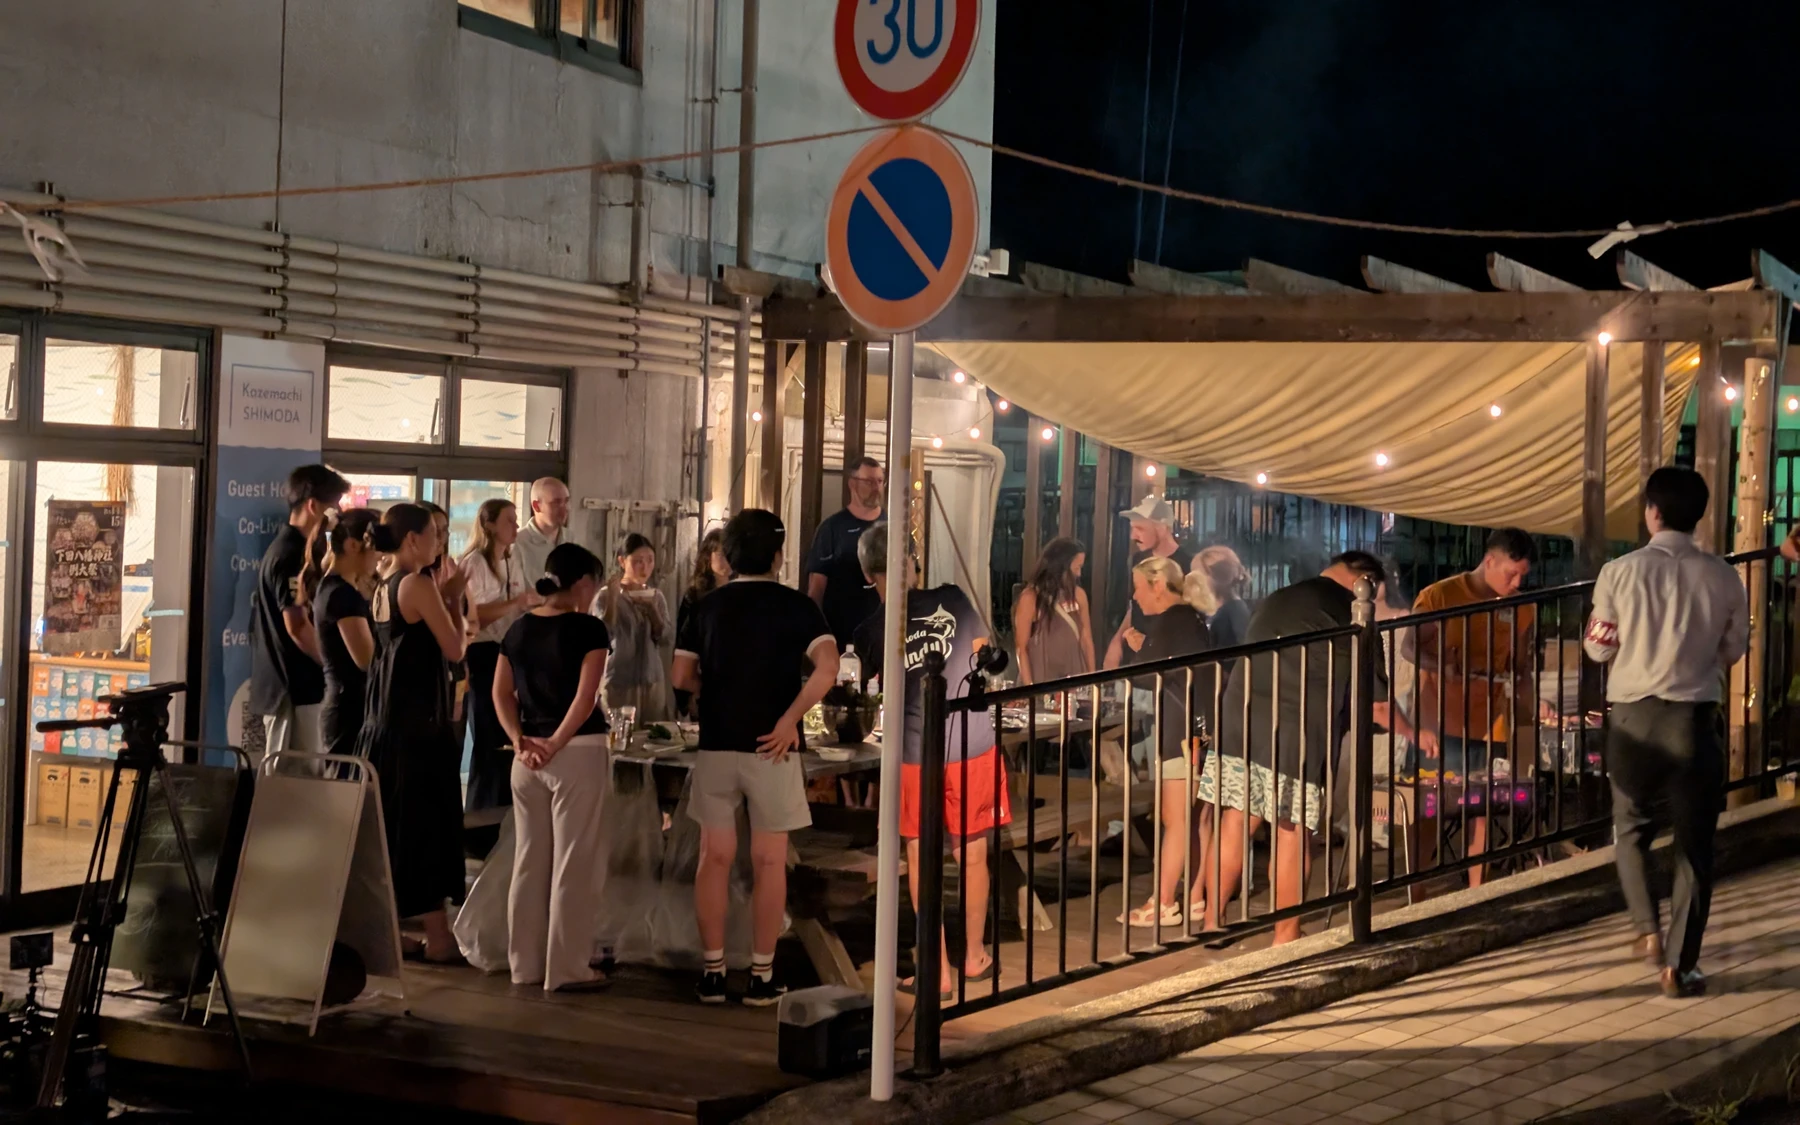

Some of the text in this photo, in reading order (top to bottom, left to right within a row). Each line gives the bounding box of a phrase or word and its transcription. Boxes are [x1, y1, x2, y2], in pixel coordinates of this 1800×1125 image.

[866, 0, 943, 65] 30
[242, 382, 303, 402] Kazemachi
[243, 406, 300, 423] SHIMODA
[228, 479, 266, 497] Guest
[222, 628, 250, 648] Eve
